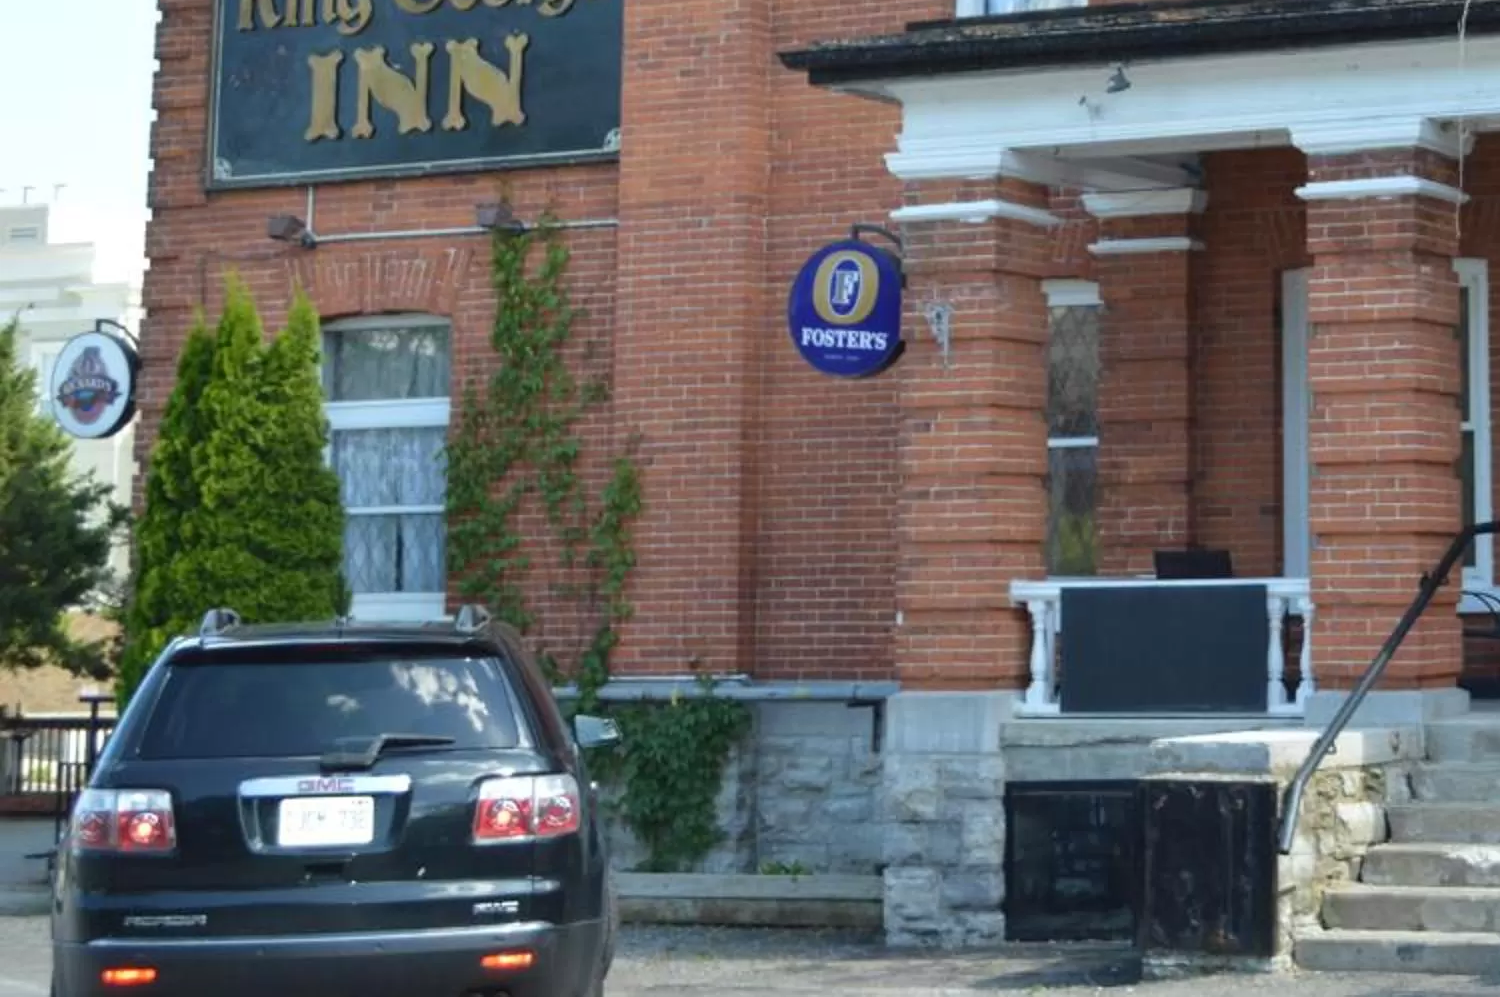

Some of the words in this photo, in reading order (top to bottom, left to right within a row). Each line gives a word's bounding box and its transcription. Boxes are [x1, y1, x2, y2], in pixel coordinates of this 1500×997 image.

[304, 29, 530, 142] INN
[801, 327, 889, 351] FOSTER'S
[297, 778, 355, 794] GMC
